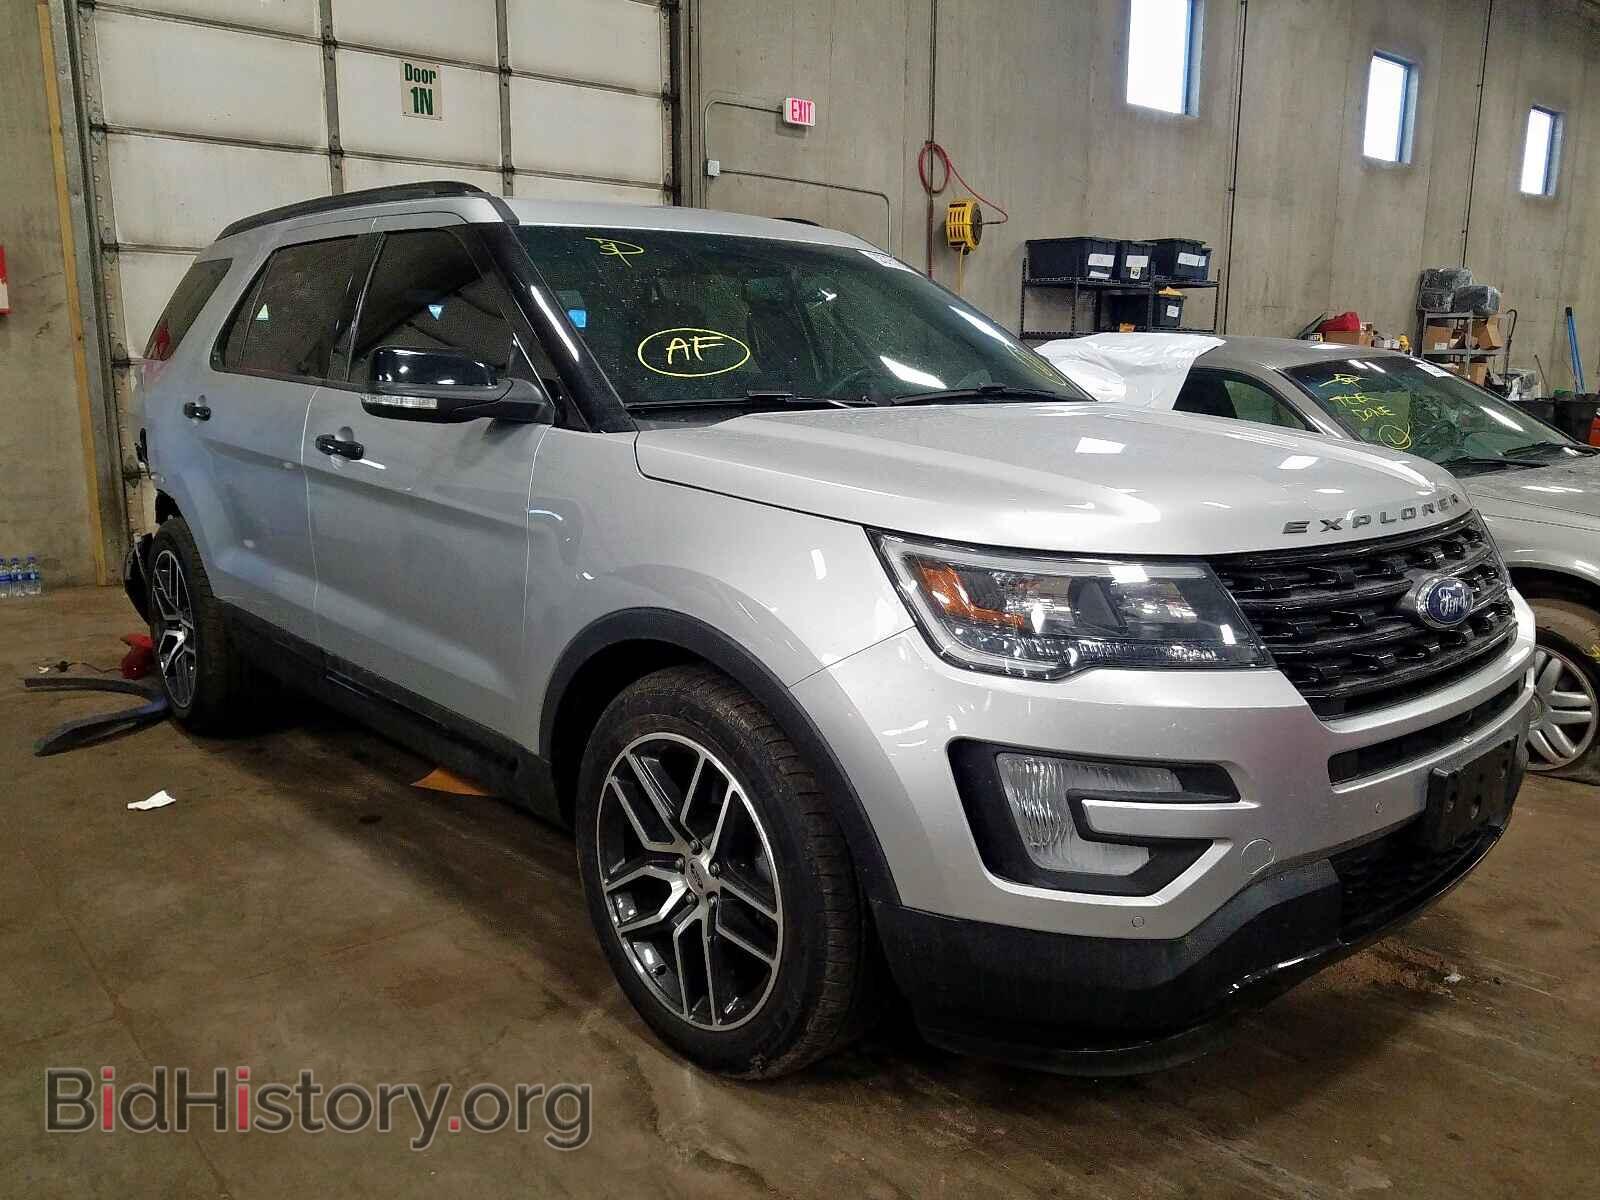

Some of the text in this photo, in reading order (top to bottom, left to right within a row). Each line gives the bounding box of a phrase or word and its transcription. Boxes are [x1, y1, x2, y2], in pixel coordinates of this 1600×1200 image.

[404, 63, 437, 85] Door
[410, 86, 434, 116] 1N
[791, 100, 813, 124] EXIT
[666, 335, 726, 365] AF
[1282, 493, 1459, 535] EXPLORER
[1438, 586, 1468, 617] Ford
